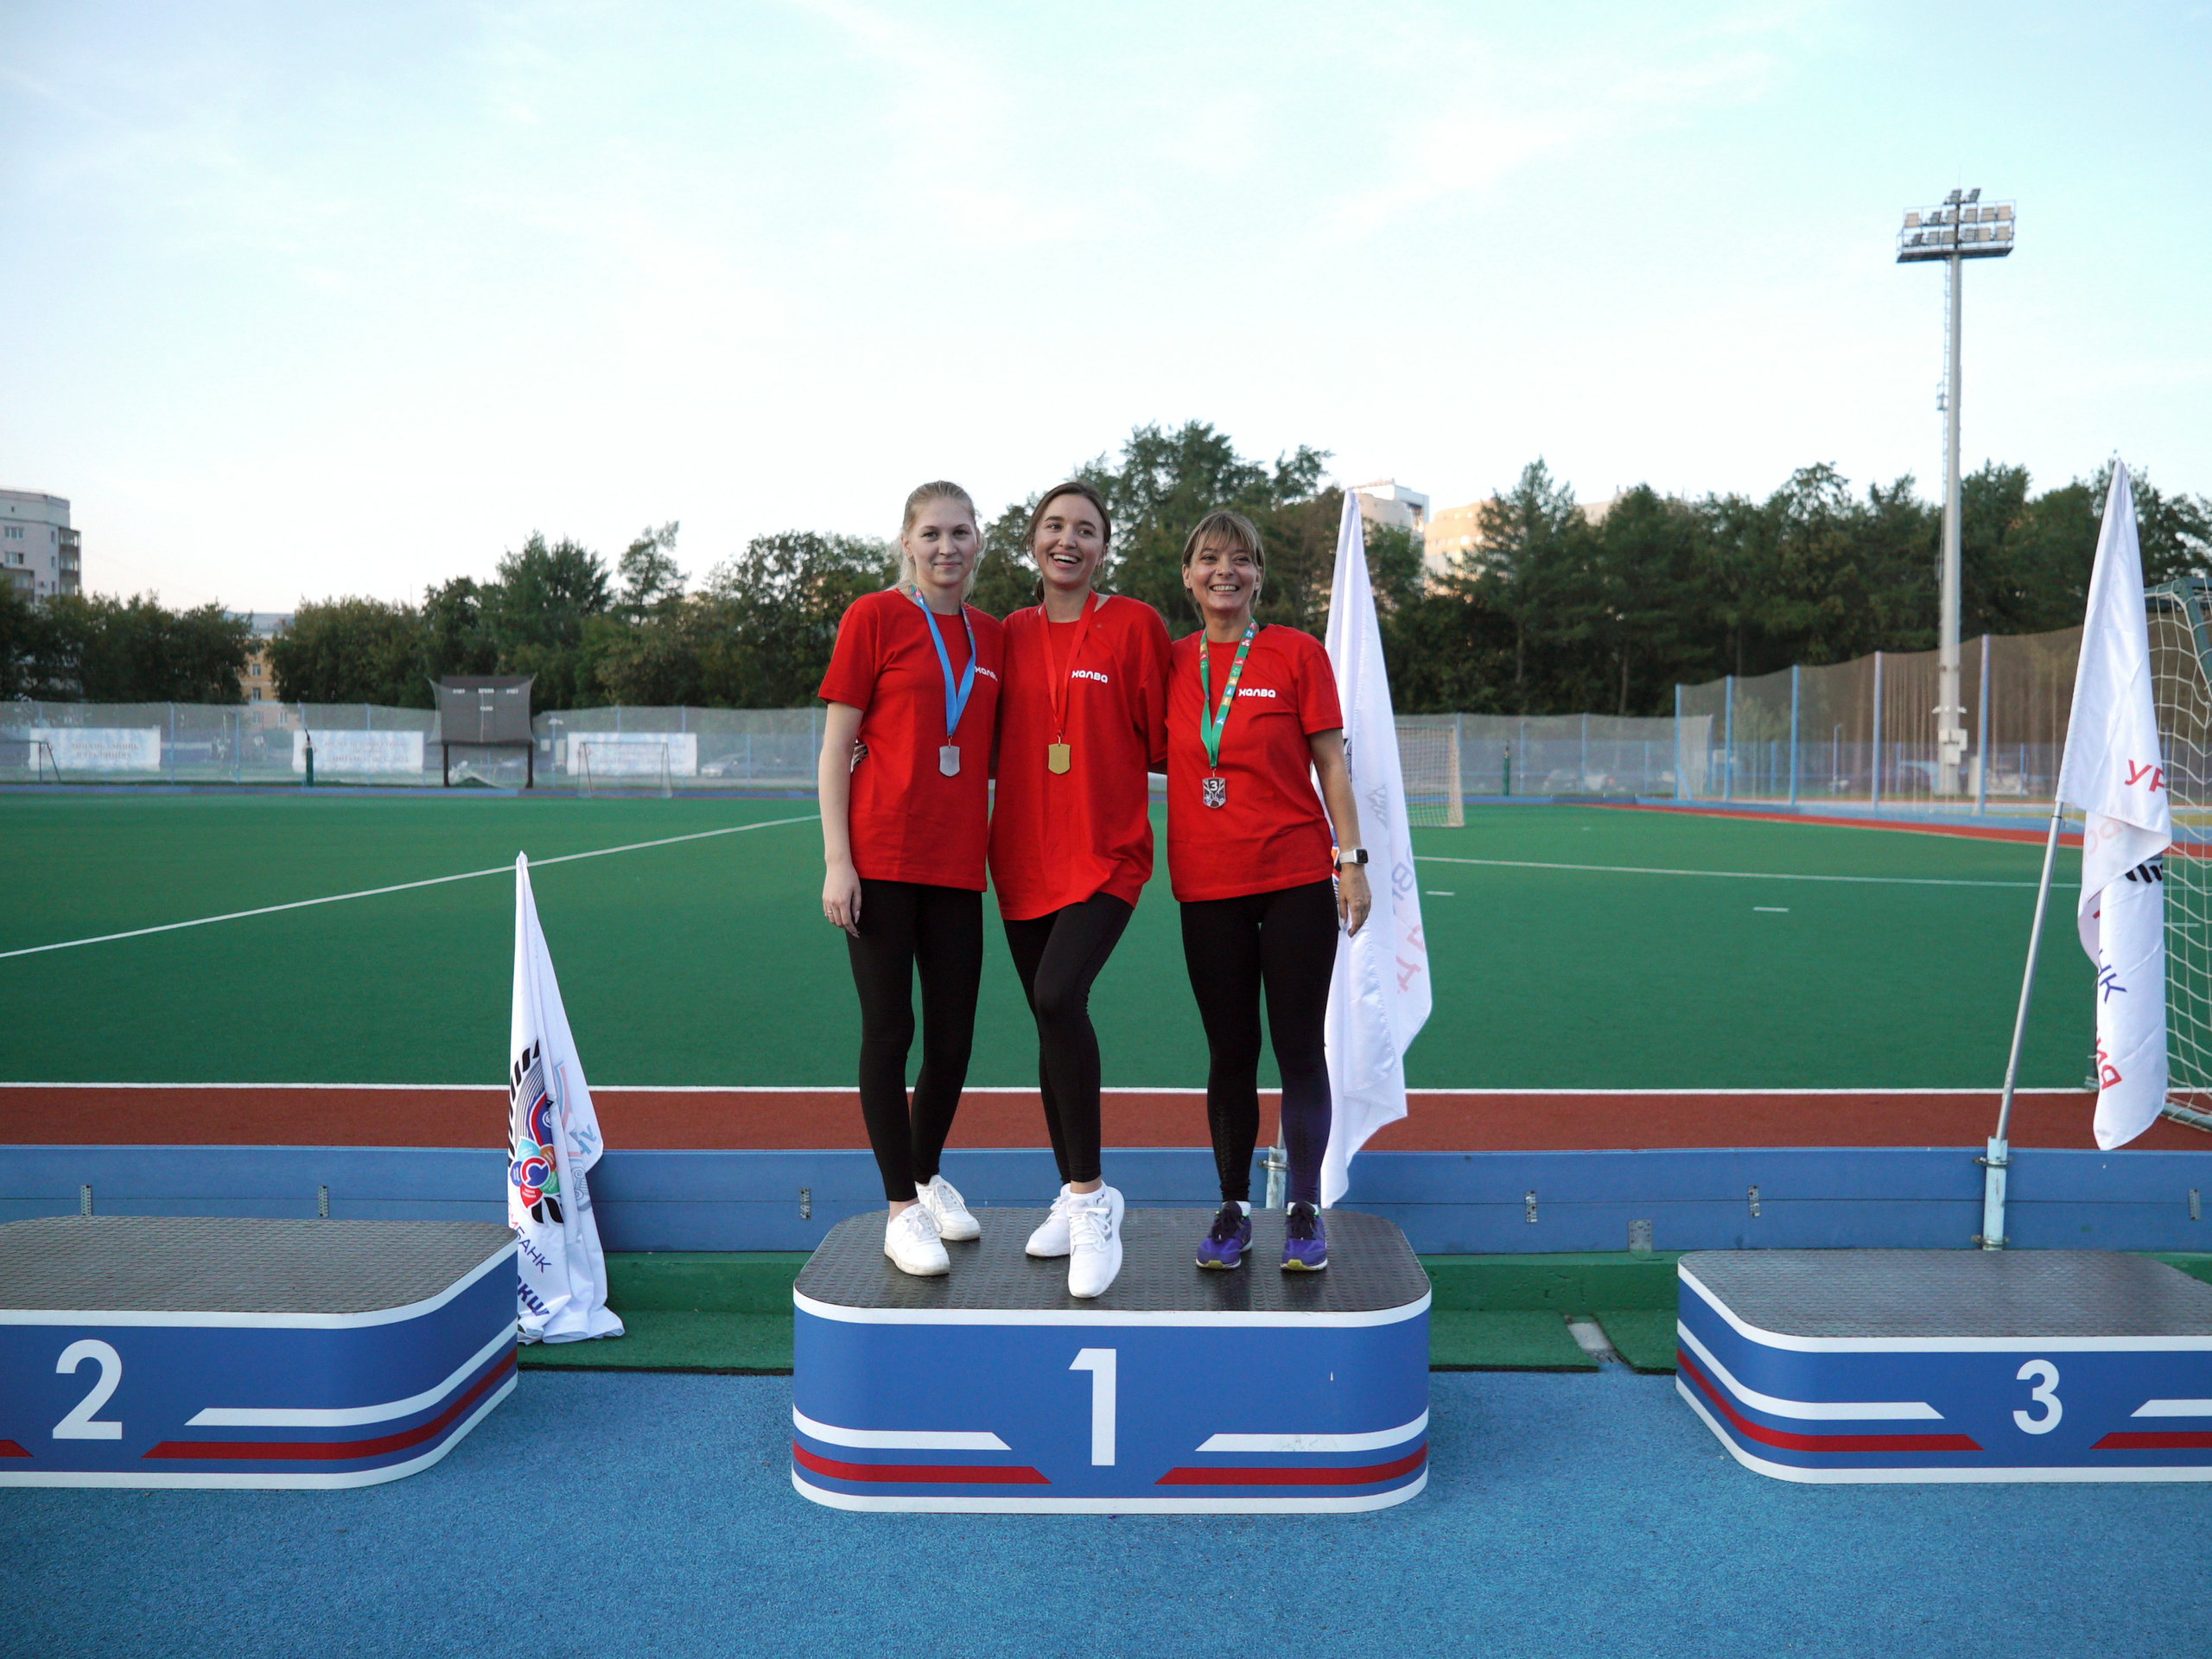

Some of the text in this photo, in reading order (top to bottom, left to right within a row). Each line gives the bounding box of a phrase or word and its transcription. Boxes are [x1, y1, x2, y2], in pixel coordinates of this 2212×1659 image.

[1210, 780, 1218, 791] 3
[52, 1338, 123, 1440] 2
[1068, 1348, 1117, 1466] 1
[2012, 1358, 2063, 1435] 3
